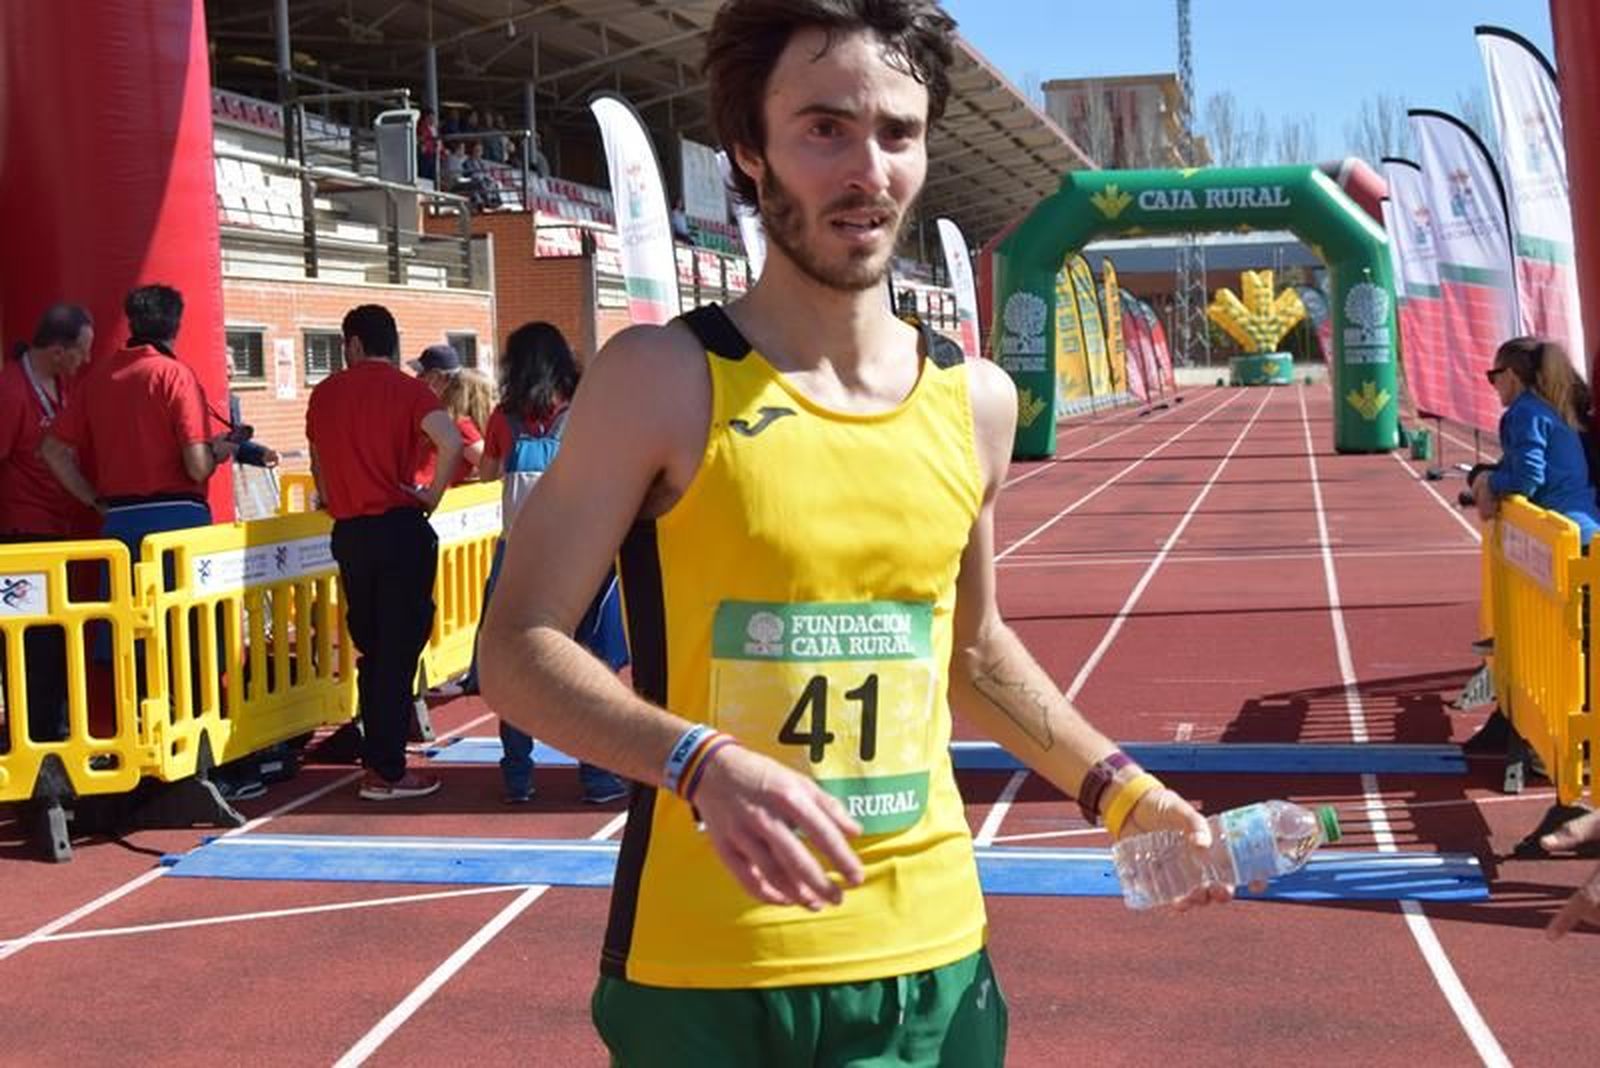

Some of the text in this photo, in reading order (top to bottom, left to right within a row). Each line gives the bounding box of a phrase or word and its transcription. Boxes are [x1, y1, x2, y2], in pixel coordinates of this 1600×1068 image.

[1138, 186, 1291, 211] CAJA RURAL
[790, 637, 844, 657] CAJA
[776, 672, 880, 765] 41
[847, 789, 920, 817] RURAL
